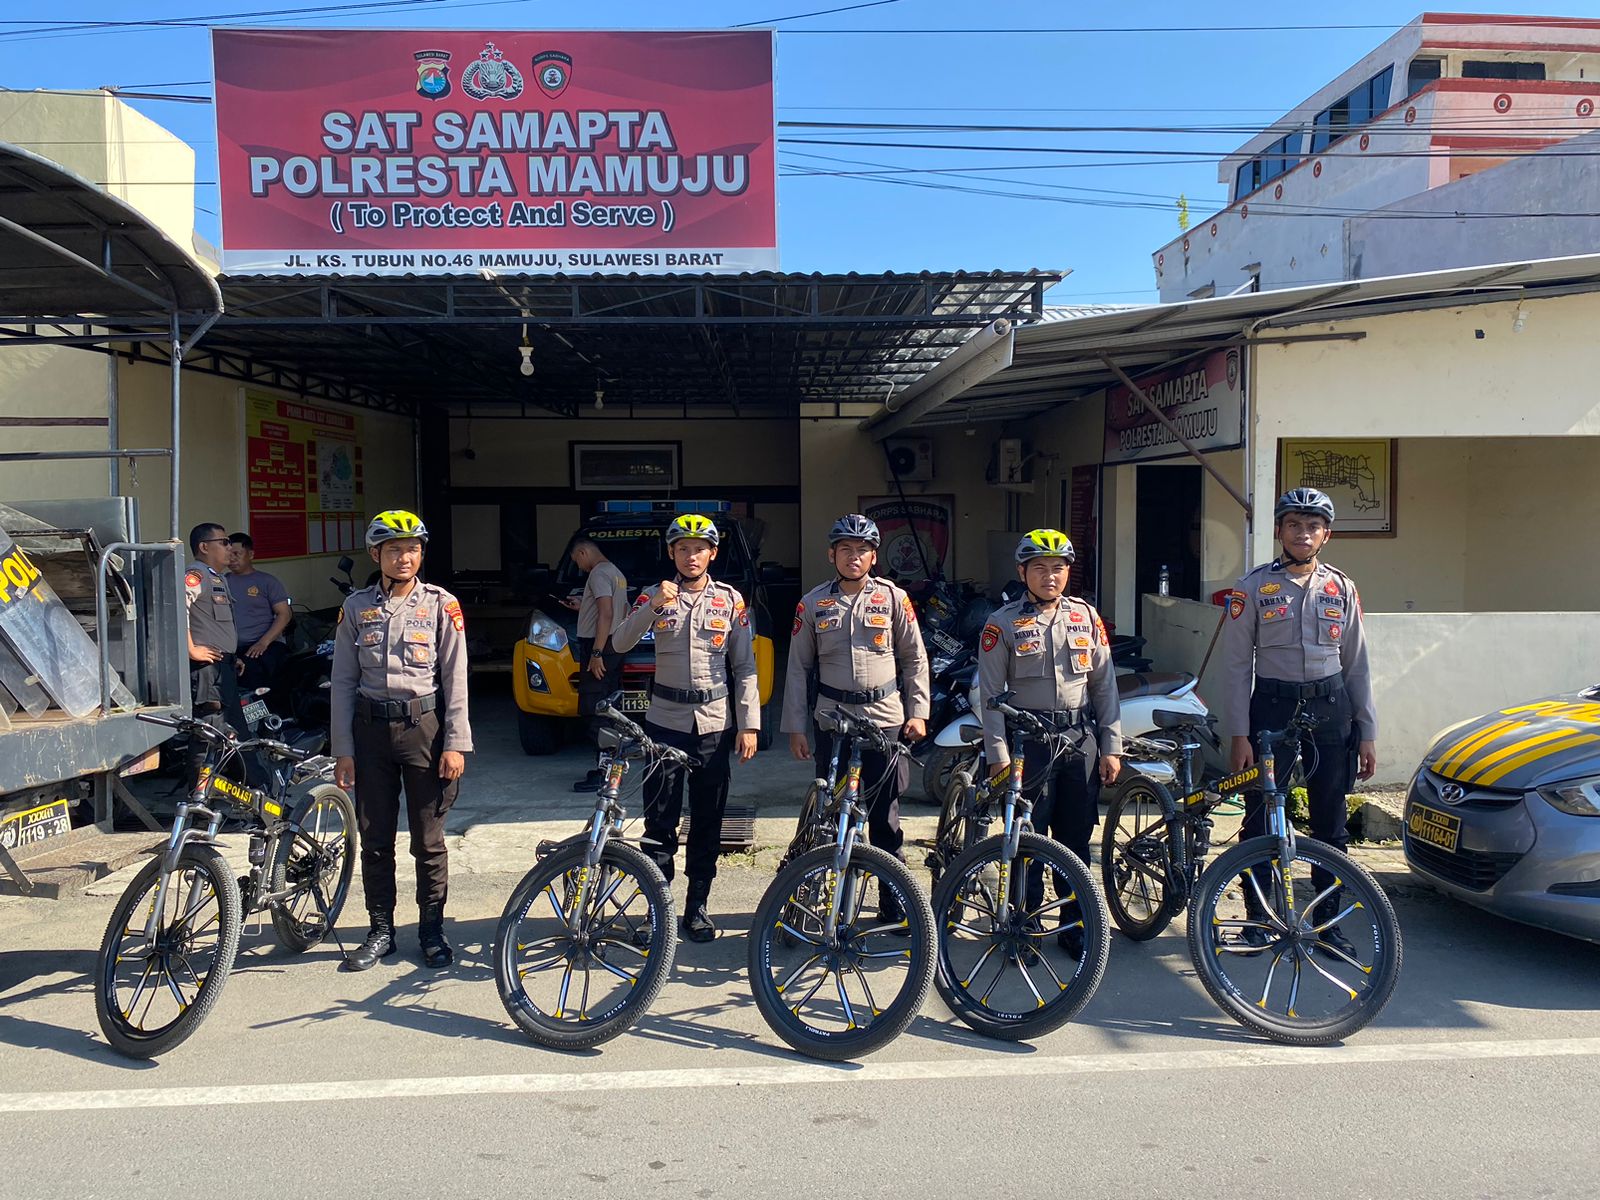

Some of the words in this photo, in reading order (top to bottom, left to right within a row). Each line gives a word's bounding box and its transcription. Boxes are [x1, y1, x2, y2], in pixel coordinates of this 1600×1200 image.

[322, 110, 419, 152] SAT
[433, 110, 674, 151] SAMAPTA
[249, 155, 514, 195] POLRESTA
[528, 154, 748, 194] MAMUJU
[347, 202, 387, 227] To
[393, 201, 503, 227] Protect
[508, 201, 565, 227] And
[570, 202, 656, 227] Serve
[283, 255, 312, 268] JL.
[316, 255, 347, 268] KS.
[352, 254, 416, 268] TUBUN
[420, 254, 473, 267] NO.46
[479, 253, 563, 269] MAMUJU,
[567, 253, 660, 266] SULAWESI
[665, 252, 724, 266] BARAT
[1149, 369, 1209, 408] SAMAPTA
[1120, 422, 1164, 451] POLRESTA
[588, 529, 661, 538] POLRESTA
[706, 608, 731, 617] POLRI
[865, 606, 890, 614] POLRI
[405, 619, 435, 628] POLRI
[1066, 625, 1090, 633] POLRI
[1218, 775, 1246, 792] POLISI
[804, 865, 828, 879] PATROLI
[965, 860, 986, 878] PATROLI
[1048, 861, 1069, 879] POLISI
[574, 867, 588, 910] POLISI
[826, 872, 837, 917] POLISI
[888, 881, 907, 905] POLISI
[999, 863, 1008, 906] POLISI
[1212, 881, 1227, 905] POLISI
[1283, 867, 1295, 910] POLISI
[518, 899, 532, 925] POLISI
[1372, 924, 1380, 954] POLISI
[1074, 950, 1088, 978] PATROLI
[1220, 971, 1242, 996] PATROLI
[522, 995, 541, 1015] PATROLI
[604, 1000, 627, 1019] POLISI
[805, 1025, 831, 1037] PATROLI
